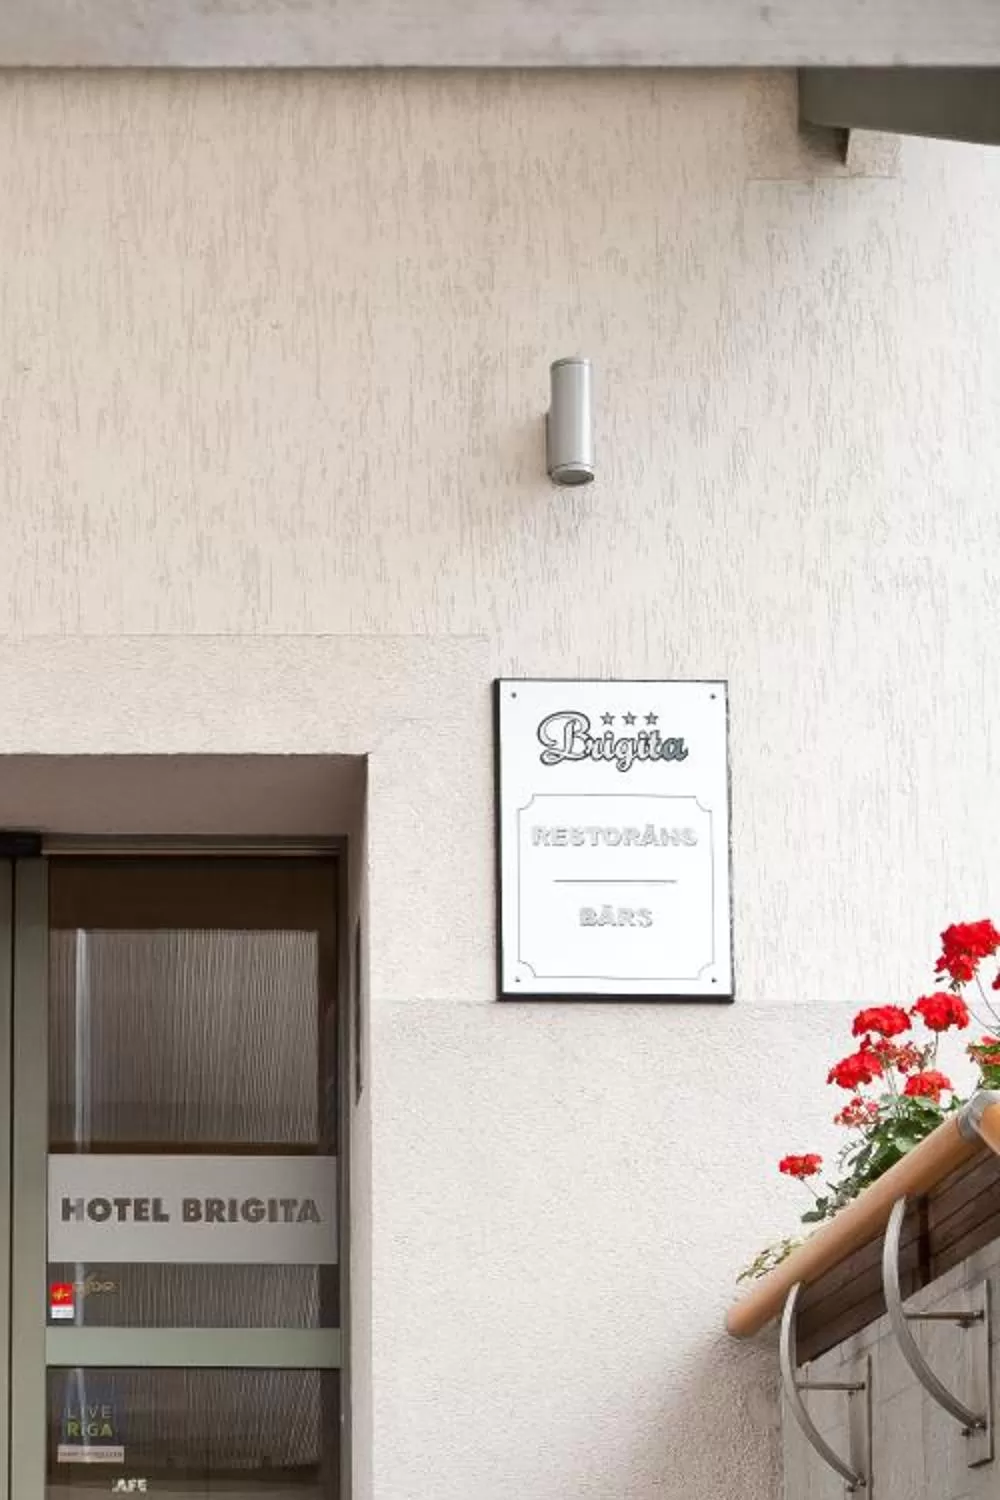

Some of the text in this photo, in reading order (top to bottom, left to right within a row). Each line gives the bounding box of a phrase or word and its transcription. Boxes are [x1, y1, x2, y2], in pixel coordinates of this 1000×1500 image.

[537, 710, 689, 772] Brigita
[531, 823, 698, 847] RESTORĀNS
[578, 904, 654, 928] BĀRS
[61, 1197, 323, 1223] HOTEL BRIGITA
[67, 1403, 112, 1419] LIVE
